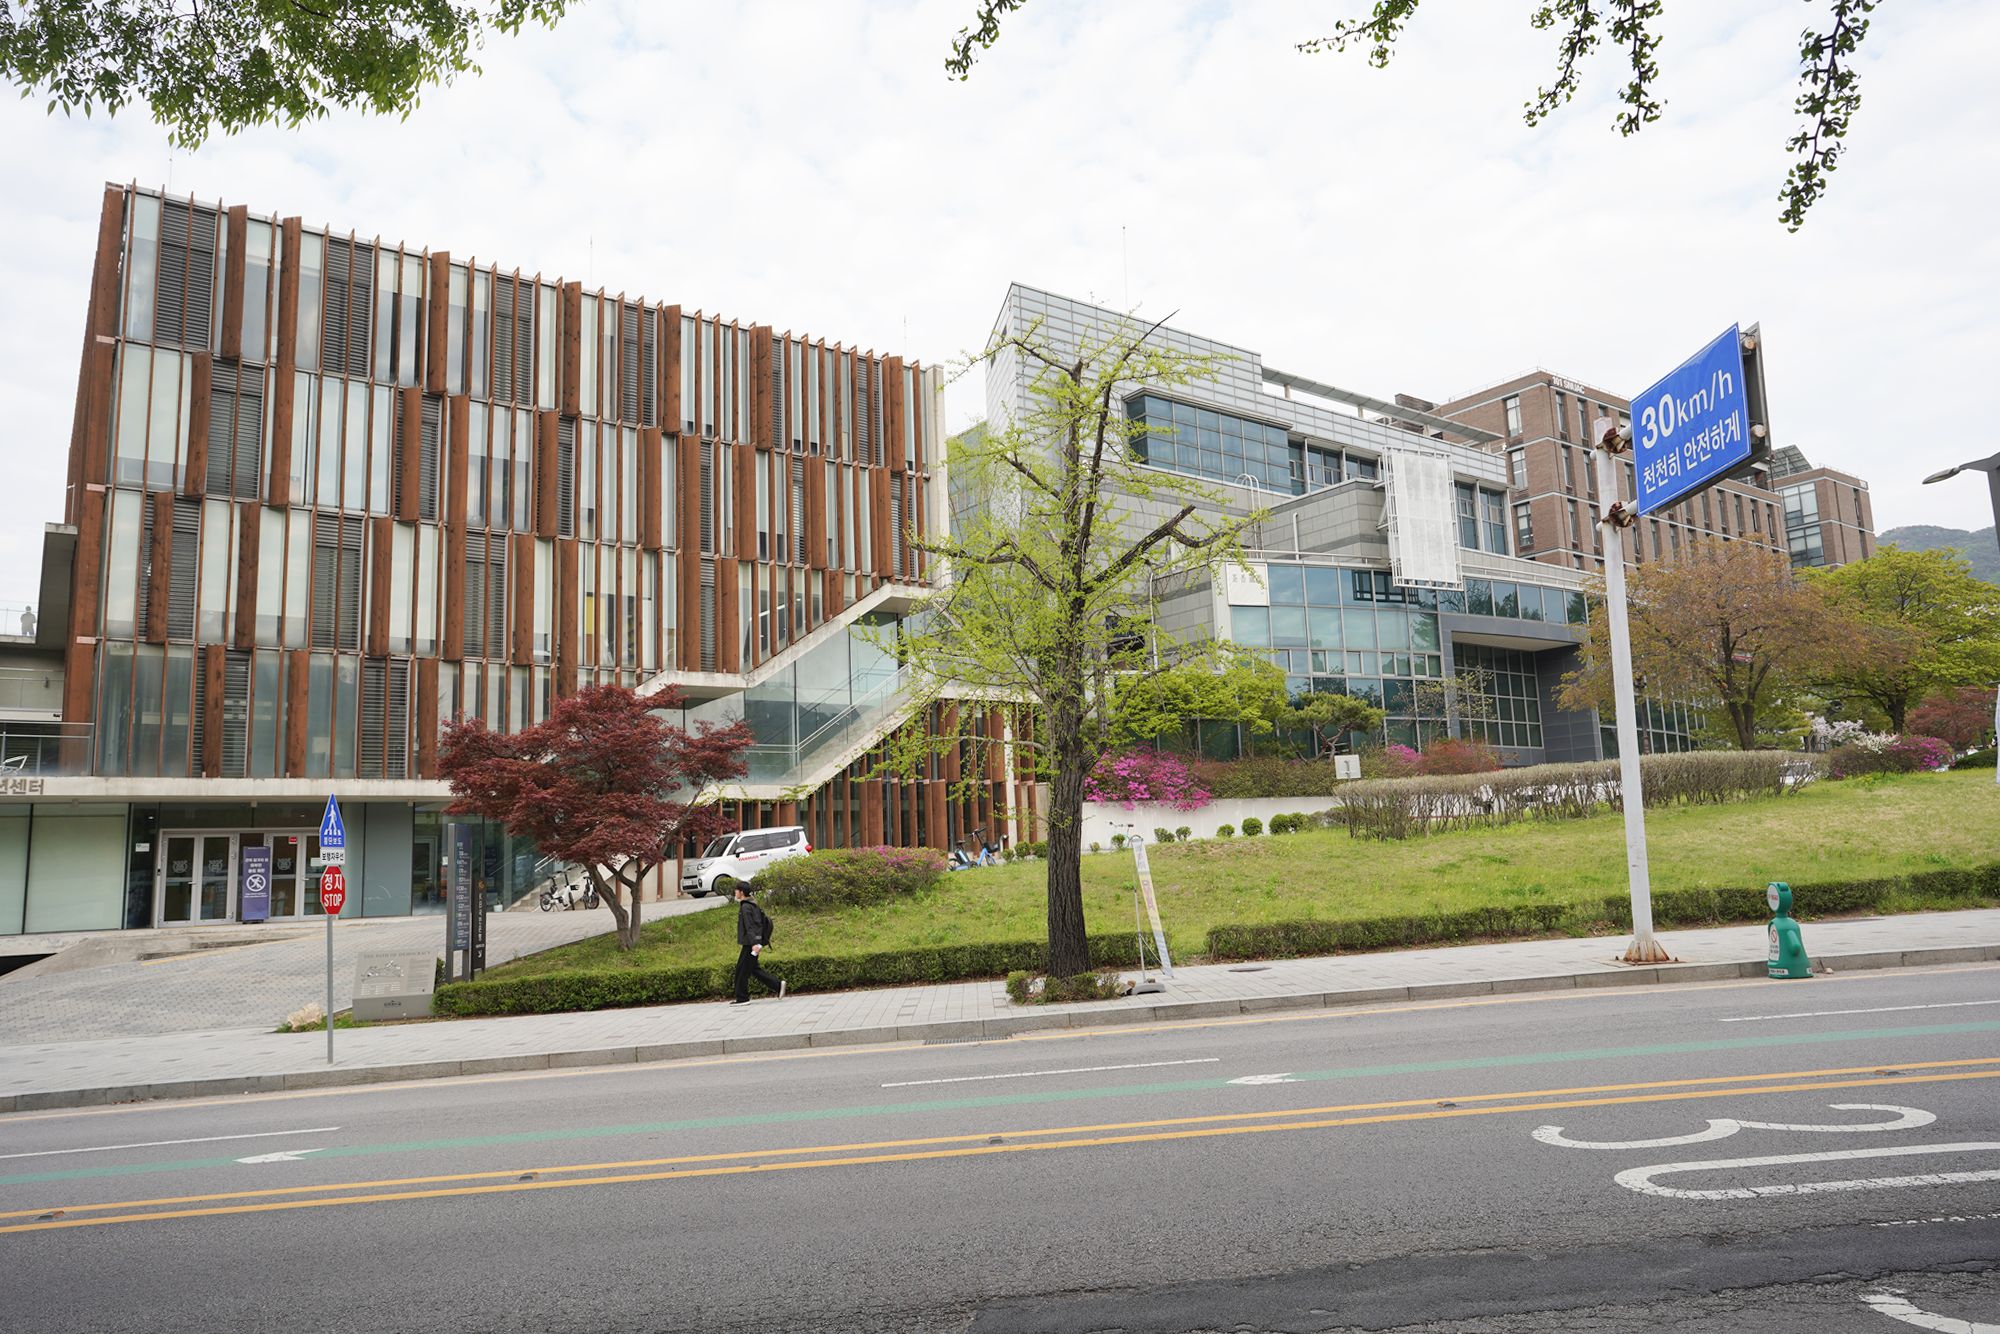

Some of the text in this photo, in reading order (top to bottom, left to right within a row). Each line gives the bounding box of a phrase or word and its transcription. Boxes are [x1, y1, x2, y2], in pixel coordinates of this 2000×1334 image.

[1641, 369, 1733, 449] 30km/h
[1643, 410, 1741, 494] 천천히 안전하게
[324, 873, 343, 891] 정지
[324, 893, 342, 907] STOP
